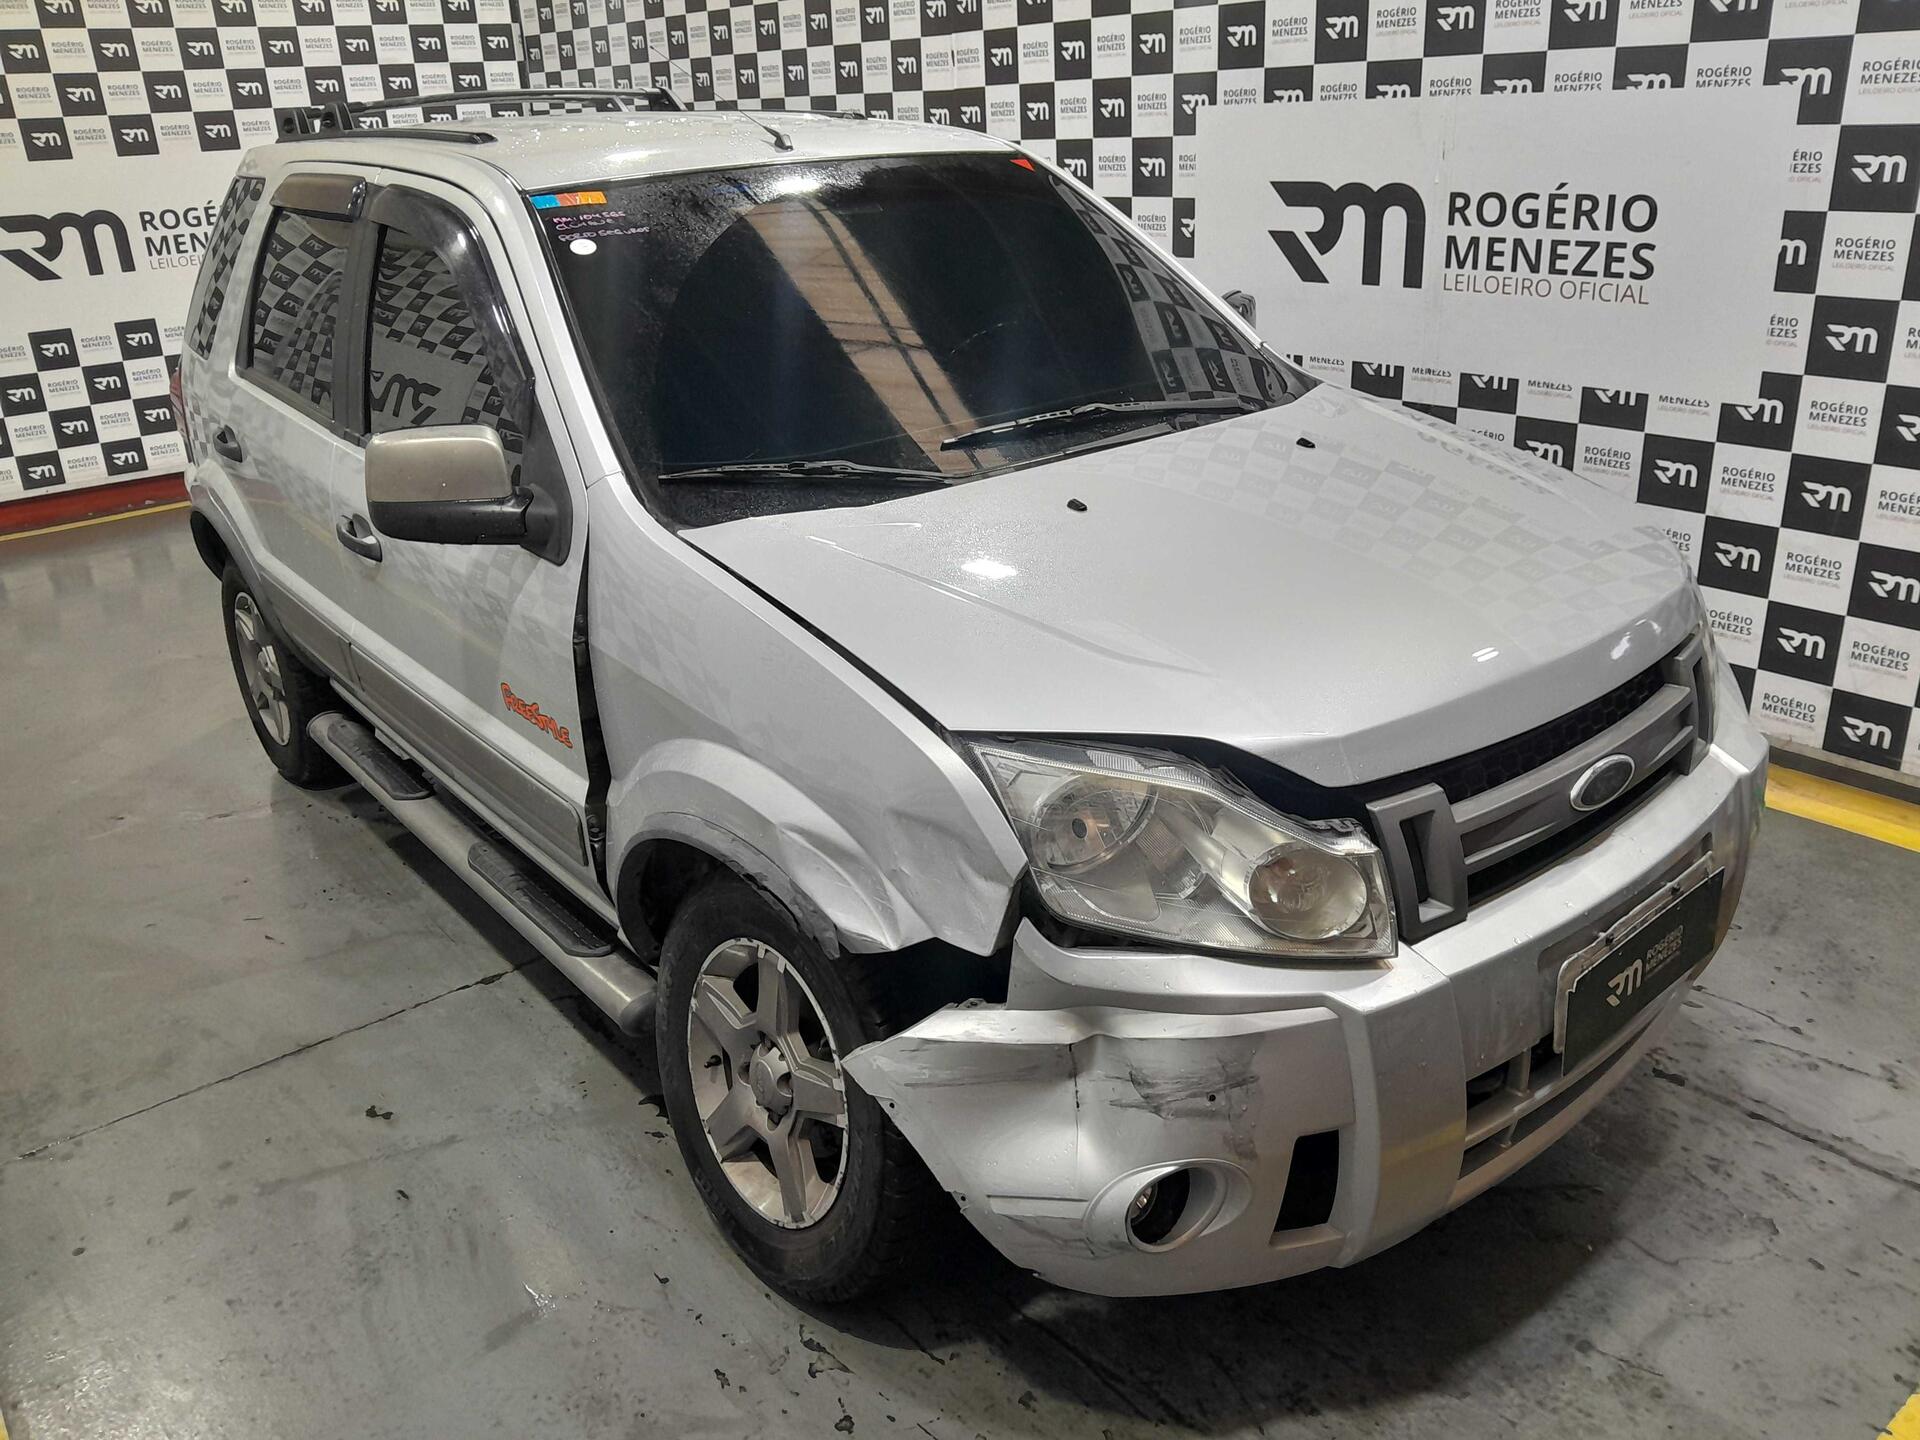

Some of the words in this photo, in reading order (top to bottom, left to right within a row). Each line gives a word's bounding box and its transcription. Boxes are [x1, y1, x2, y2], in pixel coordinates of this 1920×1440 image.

[1377, 7, 1416, 19] ROGÉRIO
[1495, 7, 1541, 19] MENEZES
[1272, 16, 1307, 27] ROGÉRIO
[1376, 18, 1417, 29] MENEZES
[1272, 26, 1308, 37] MENEZES
[1555, 71, 1602, 83] ROGÉRIO
[1697, 64, 1751, 79] ROGÉRIO
[1430, 77, 1471, 89] ROGÉRIO
[1792, 149, 1822, 162] ÉRIO
[1793, 162, 1822, 174] EZES
[139, 200, 216, 231] ROGÉ
[1448, 183, 1657, 233] ROGÉRIO
[1835, 236, 1896, 250] ROGÉRIO
[1445, 235, 1656, 280] MENEZES
[1834, 250, 1894, 261] MENEZES
[1443, 273, 1552, 298] LEILOEIRO
[1560, 280, 1649, 305] OFICIAL
[1770, 314, 1798, 328] ÉRIO
[1770, 327, 1798, 339] EZES
[1811, 399, 1868, 416] ROGÉRIO
[1809, 411, 1867, 427] MENEZES
[1585, 445, 1631, 461] ROGÉRIO
[1584, 455, 1630, 471] MENEZES
[1723, 466, 1775, 482] ROGÉRIO
[1721, 476, 1774, 493] MENEZES
[1787, 550, 1841, 571] ROGÉRIO
[1785, 562, 1841, 581] MENEZES
[1707, 609, 1753, 626] OGÉRIO
[1712, 620, 1752, 636] ENEZES
[1853, 640, 1910, 661] ROGÉRIO
[1851, 651, 1909, 672] MENEZES
[1763, 692, 1816, 713] ROGÉRIO
[1762, 703, 1815, 723] MENEZES
